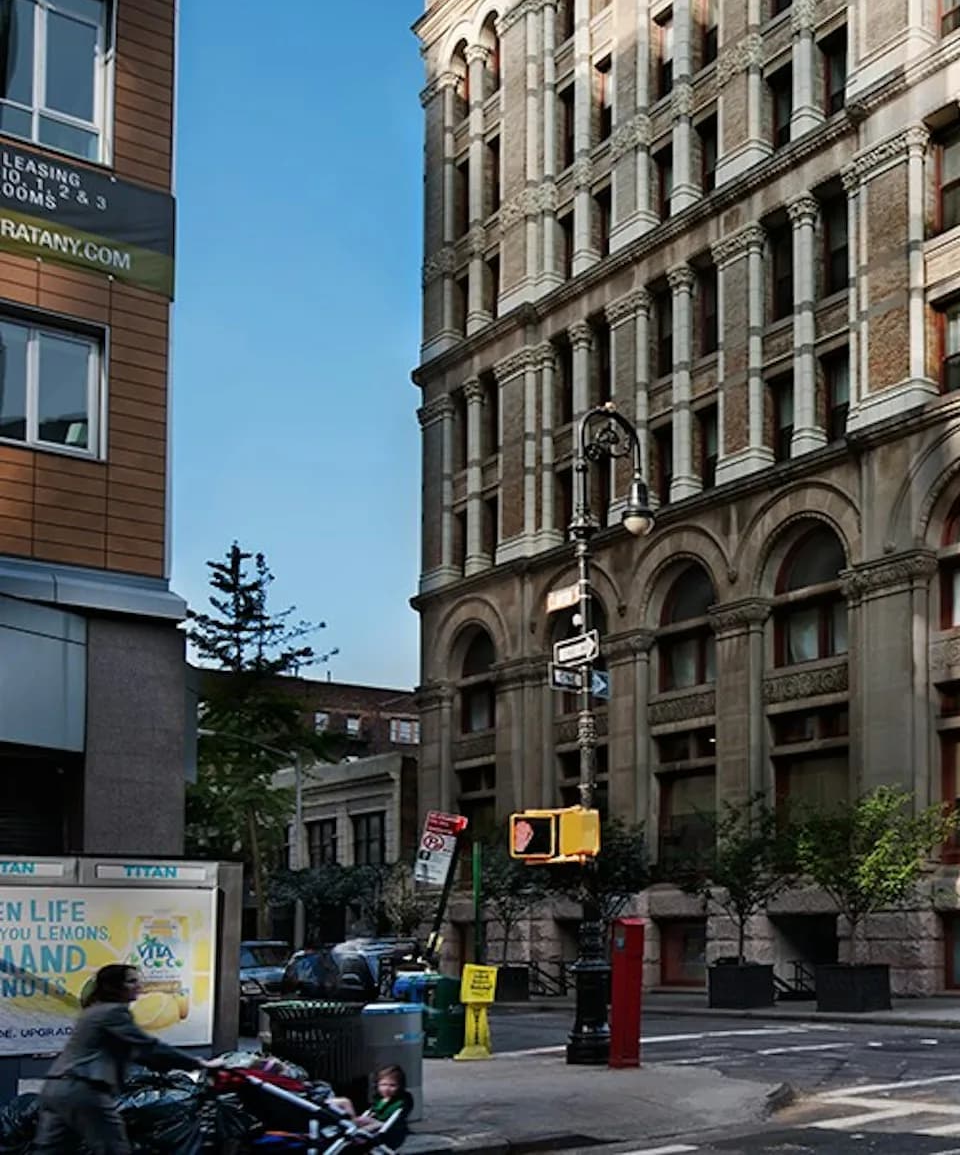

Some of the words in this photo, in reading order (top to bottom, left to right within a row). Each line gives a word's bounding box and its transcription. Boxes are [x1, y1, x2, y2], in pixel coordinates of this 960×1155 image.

[2, 151, 81, 188] LEASING
[59, 185, 70, 200] 2
[76, 190, 89, 205] &
[96, 195, 107, 211] 3
[0, 218, 131, 270] RATANY.COM
[123, 865, 178, 878] TITAN
[31, 899, 86, 923] LIFE
[0, 926, 31, 941] YOU
[37, 925, 112, 942] LEMONS,
[137, 943, 175, 959] VITA
